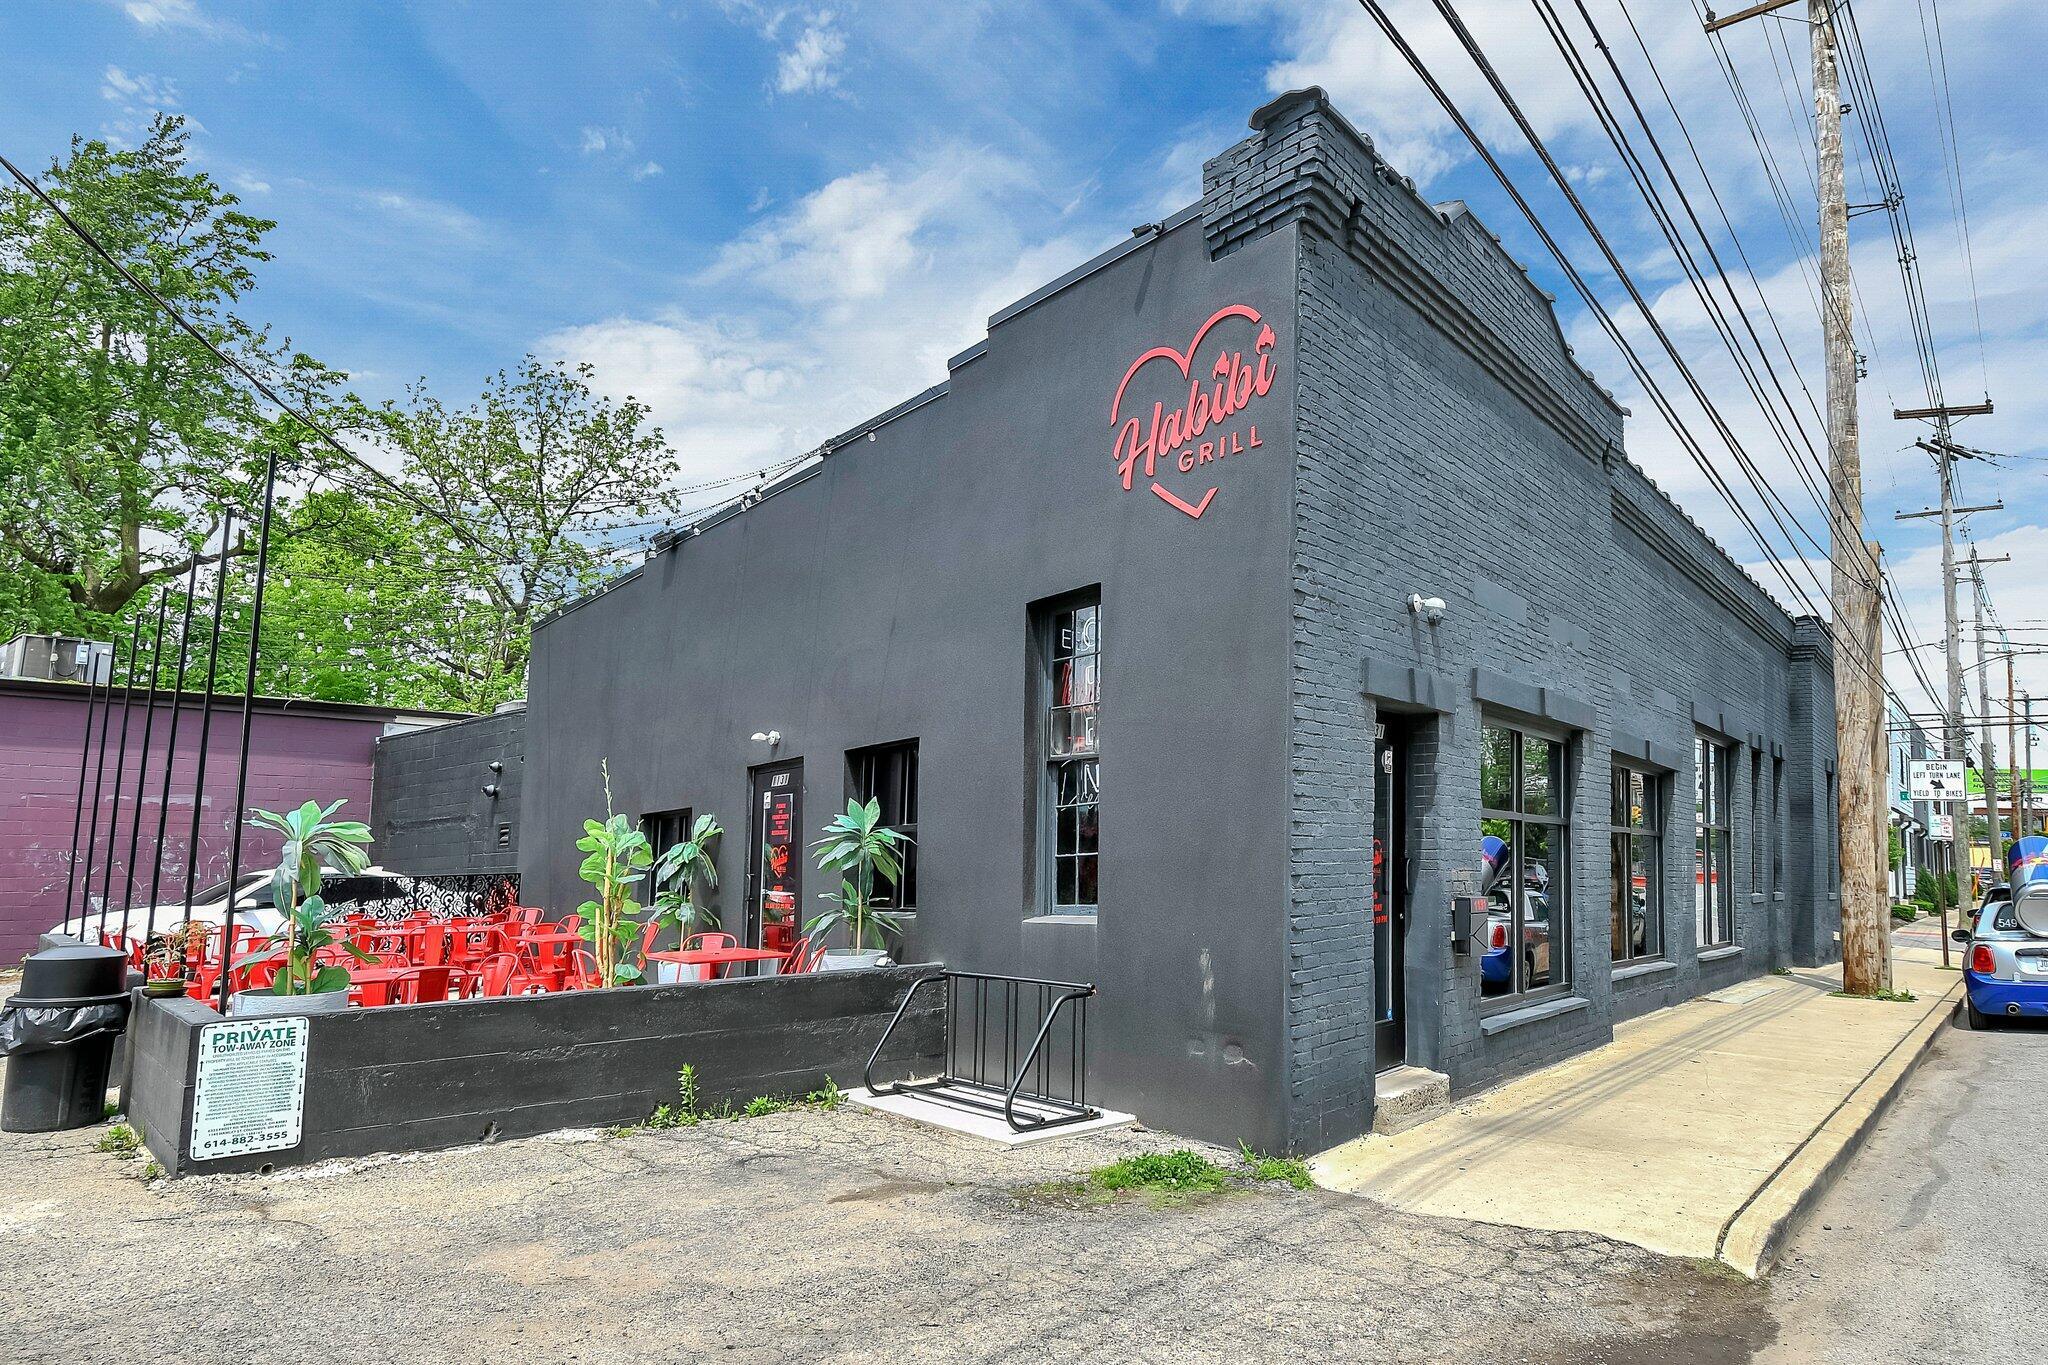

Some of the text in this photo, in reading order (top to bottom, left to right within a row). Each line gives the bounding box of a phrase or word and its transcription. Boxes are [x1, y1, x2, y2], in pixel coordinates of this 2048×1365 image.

[1113, 324, 1276, 490] Habibi
[1178, 426, 1263, 472] GRILL
[1998, 918, 2018, 928] 549
[212, 1026, 297, 1045] PRIVATE
[212, 1039, 296, 1054] TOW-AWAY ZONE
[204, 1130, 288, 1148] 614-882-3555
